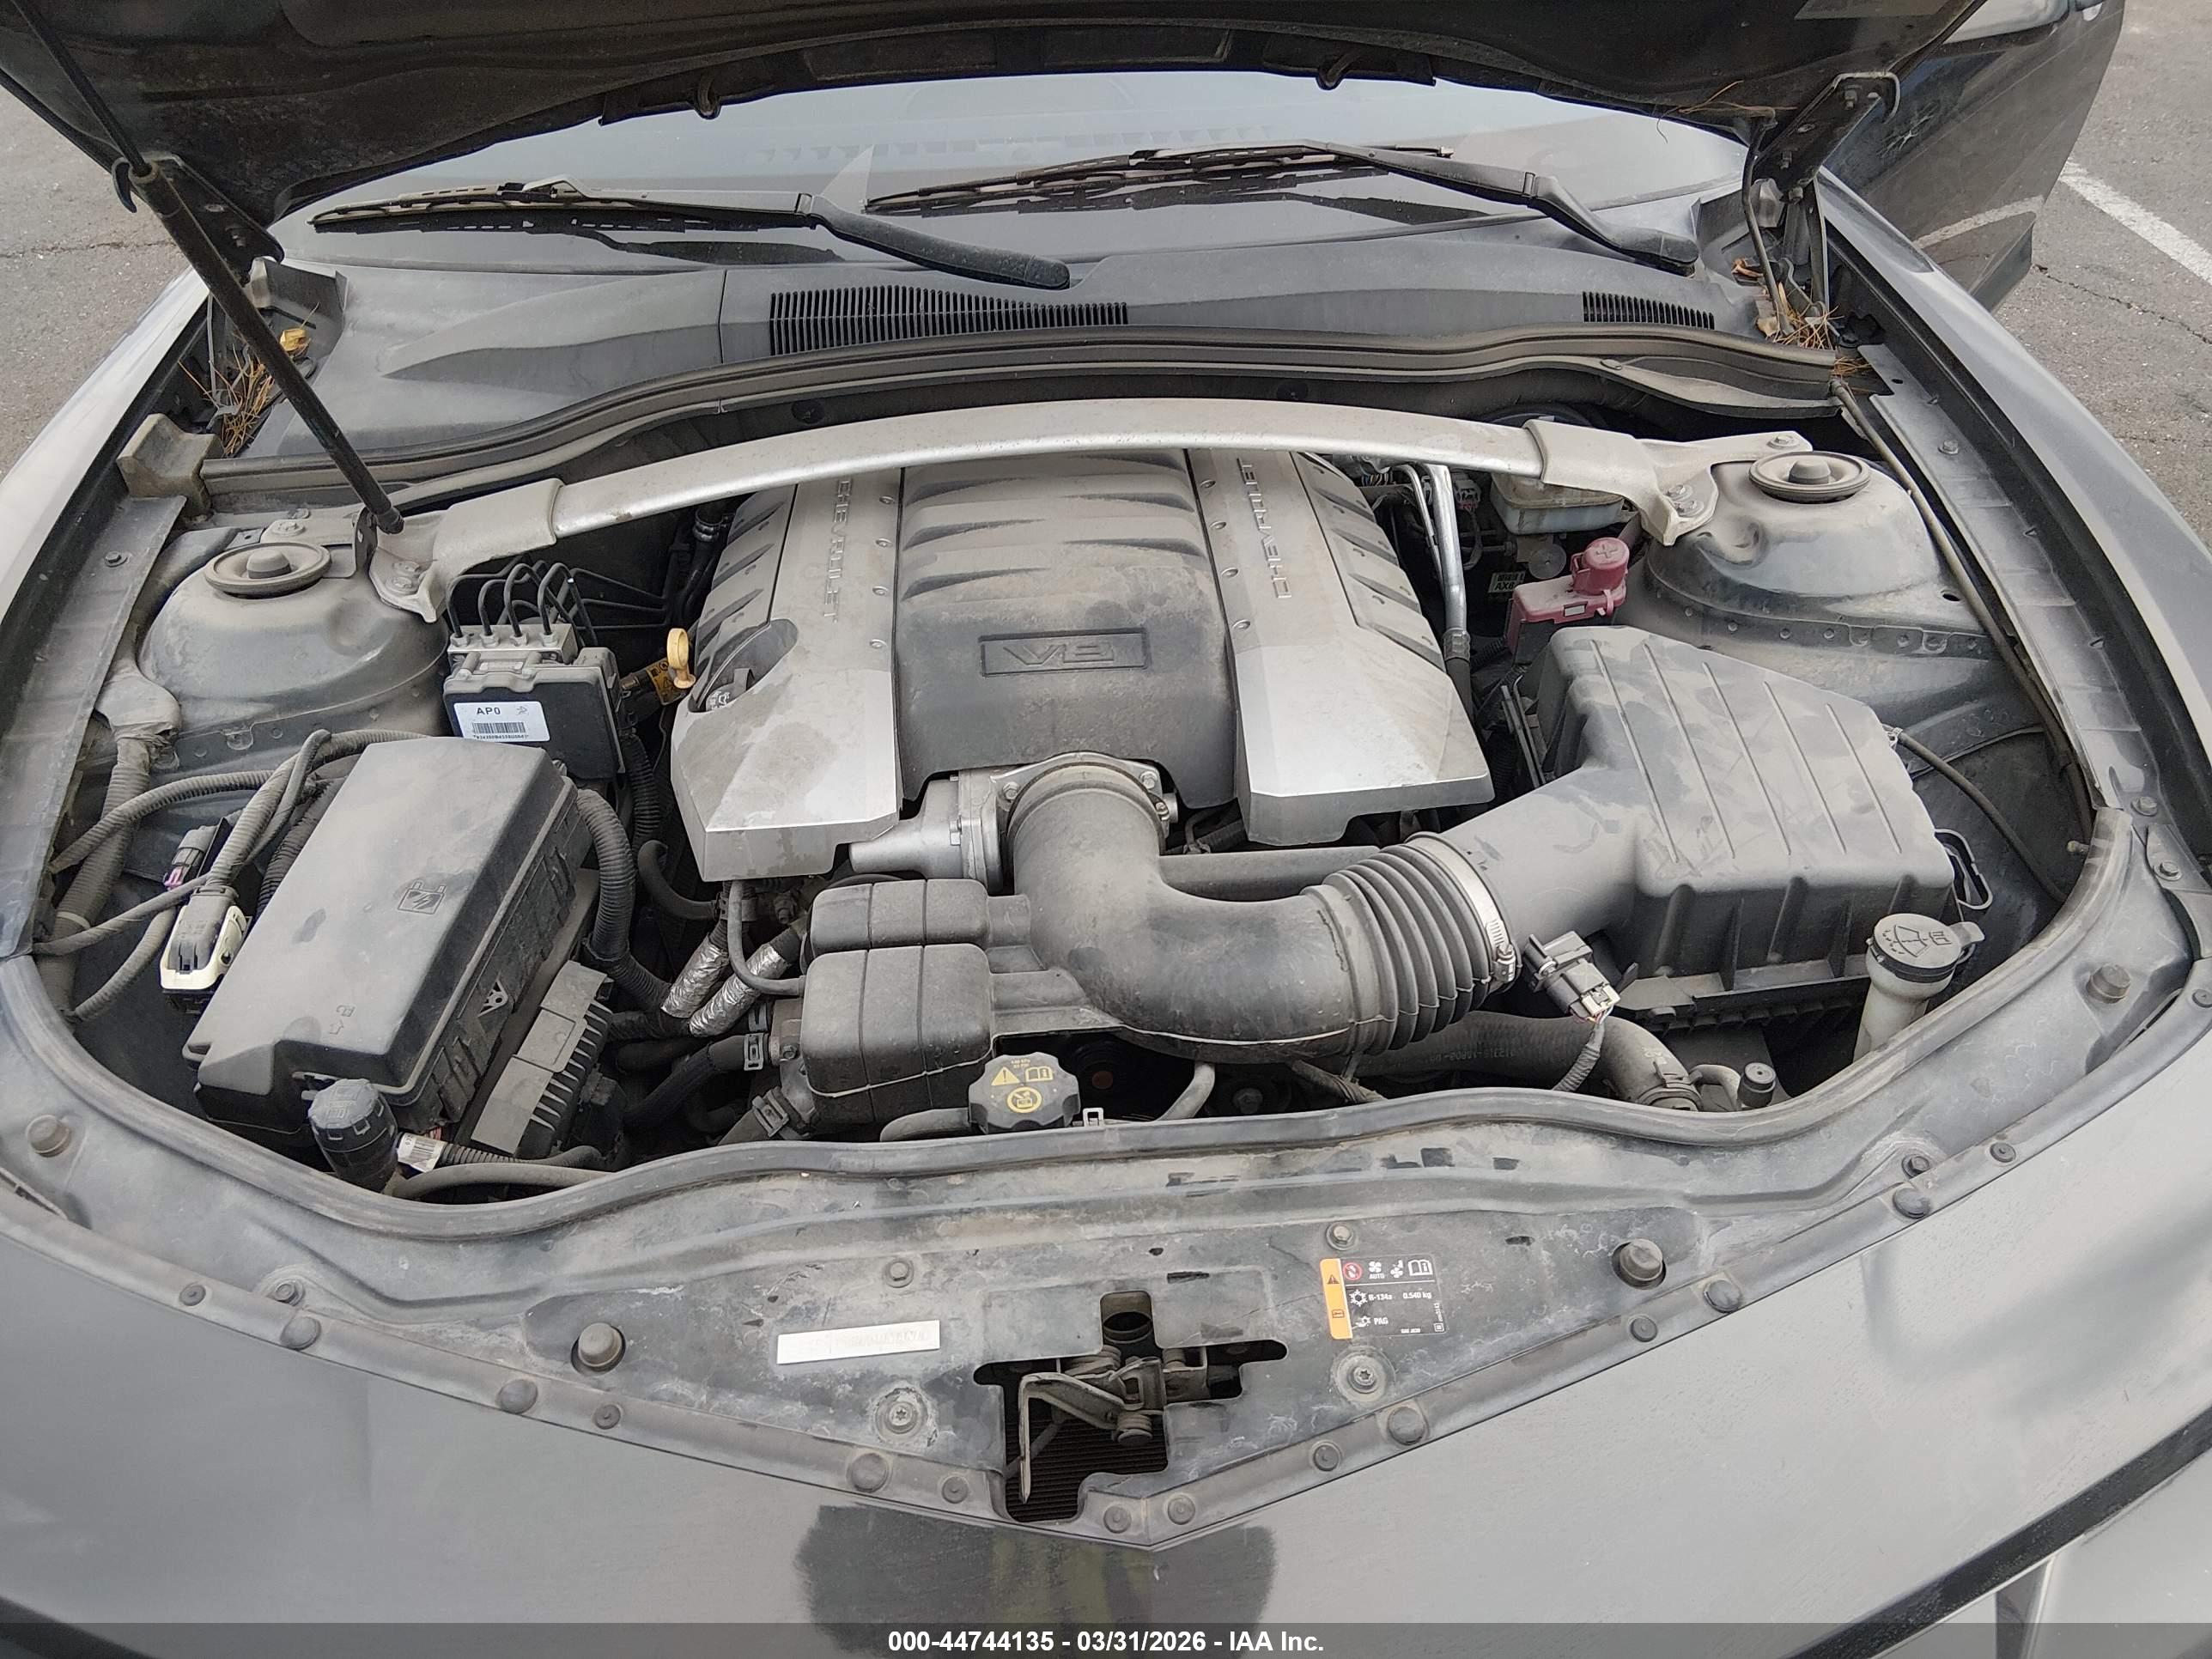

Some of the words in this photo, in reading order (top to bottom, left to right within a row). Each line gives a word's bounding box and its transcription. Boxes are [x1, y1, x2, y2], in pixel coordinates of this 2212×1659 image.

[823, 478, 853, 624] CHEVROLET
[1236, 458, 1292, 599] CHEVROLET
[1002, 641, 1115, 666] V8
